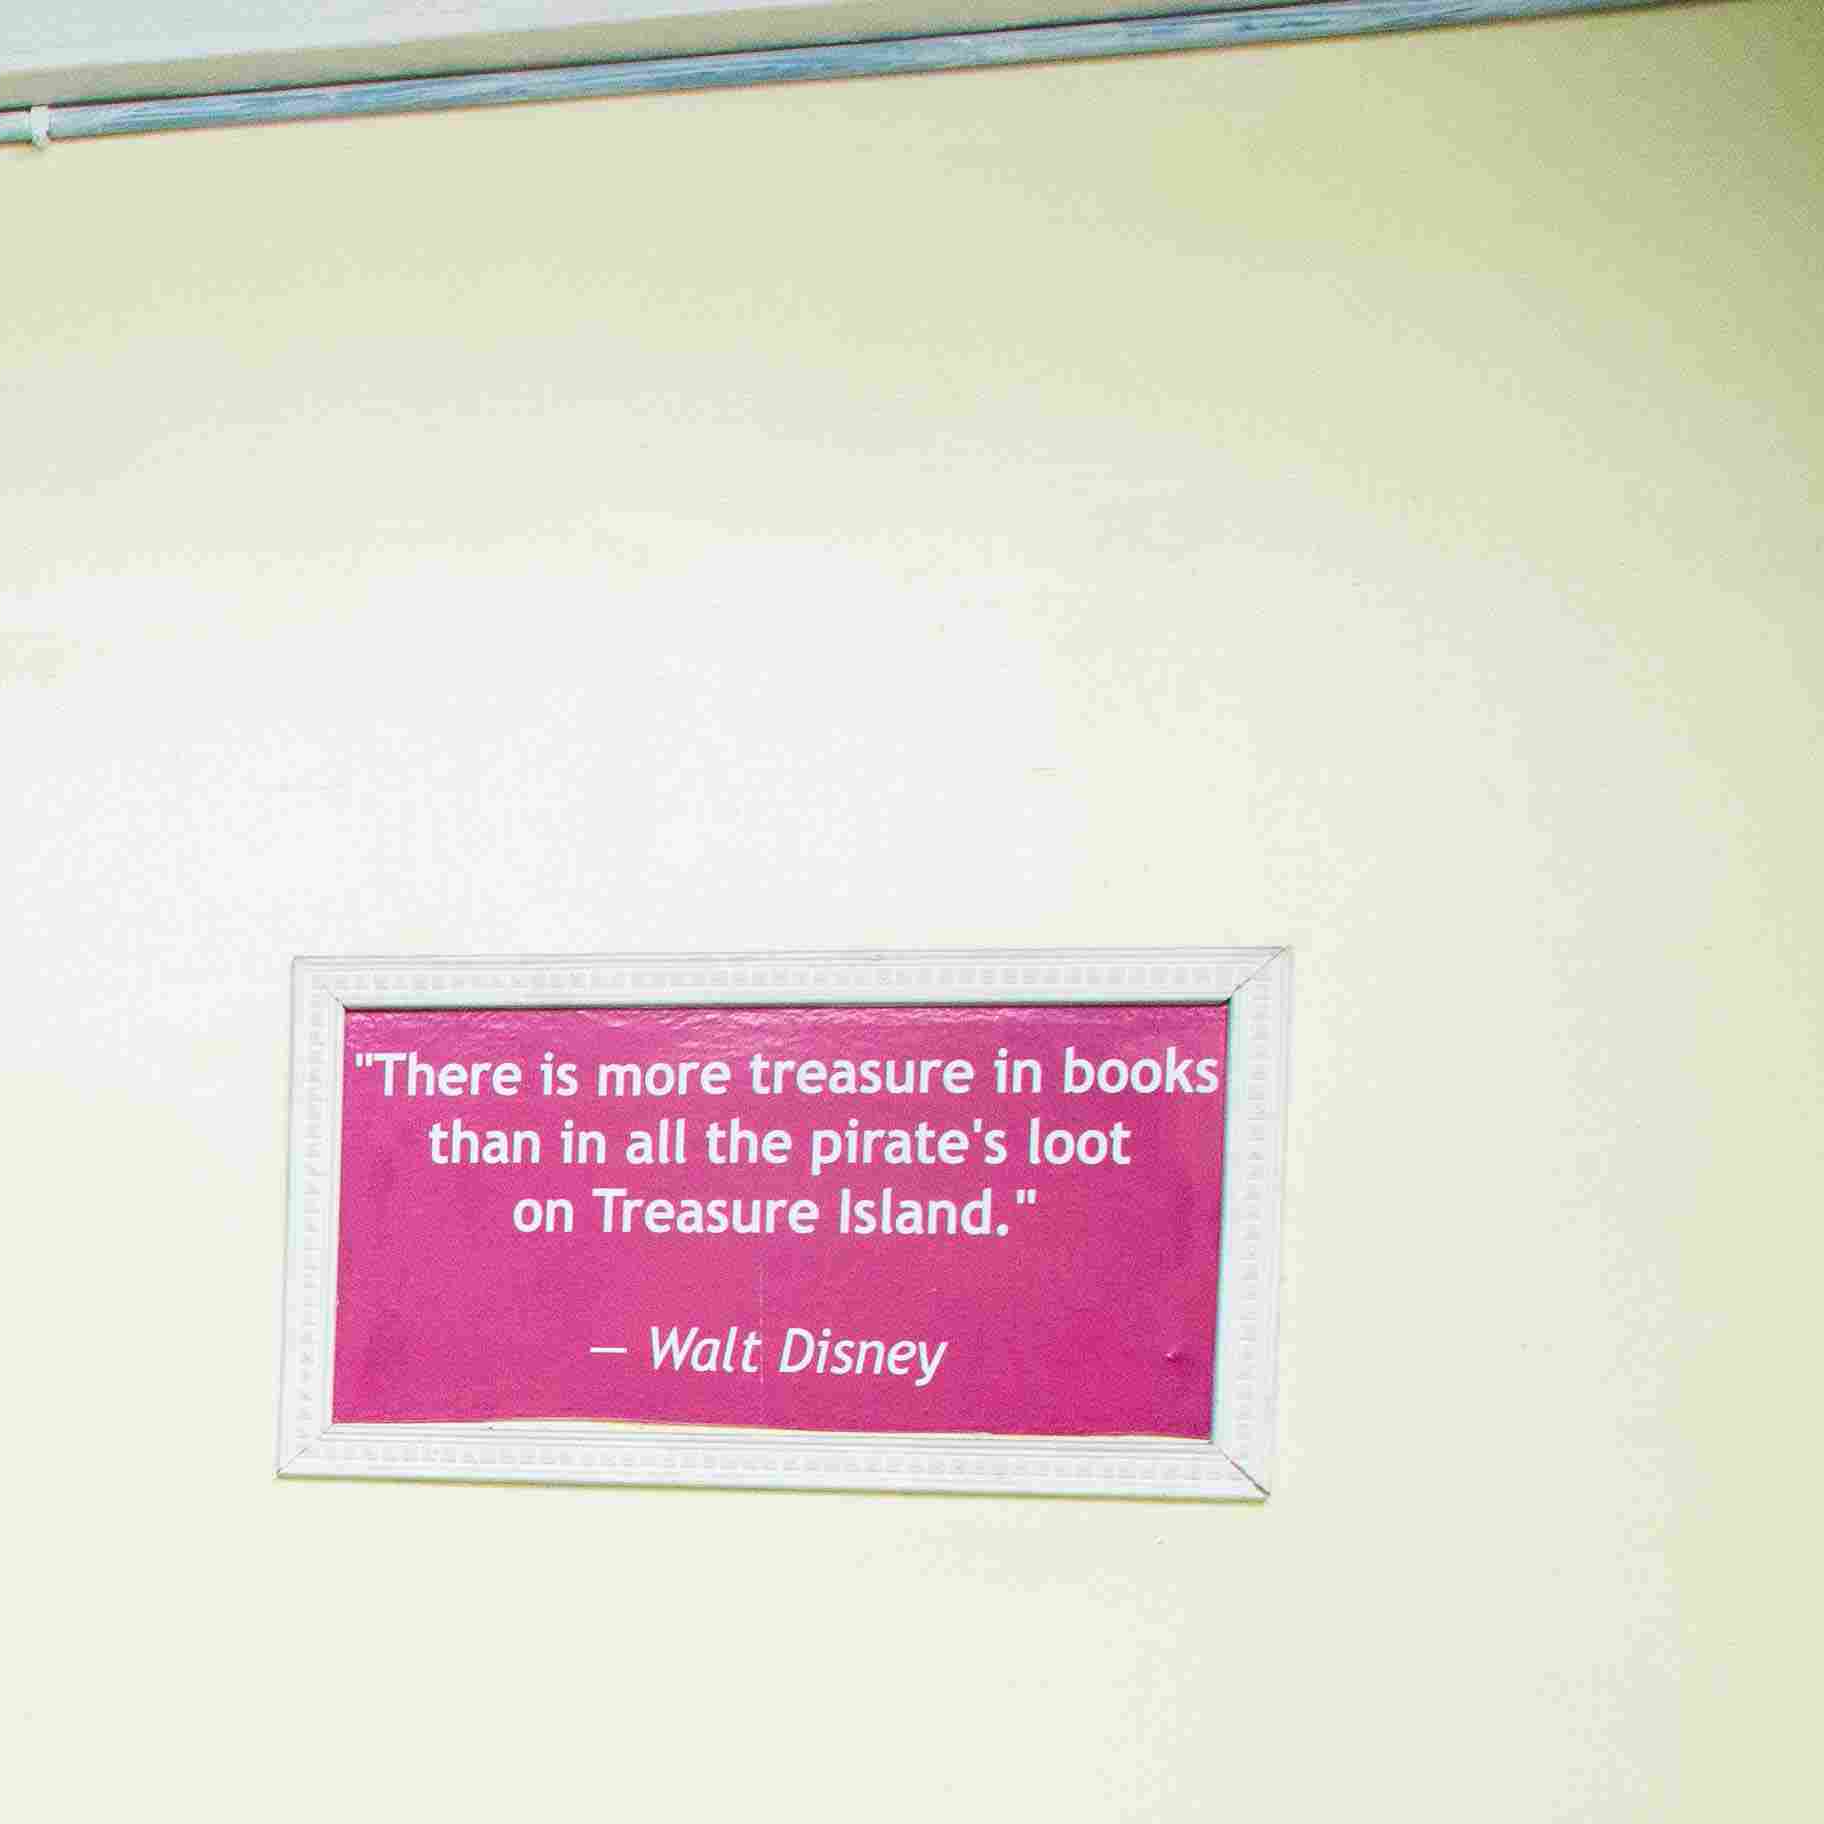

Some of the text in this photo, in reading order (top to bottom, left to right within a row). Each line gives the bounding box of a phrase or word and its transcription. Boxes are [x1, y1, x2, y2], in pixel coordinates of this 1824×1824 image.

[354, 1047, 1219, 1098] "There is more treasure in books
[429, 1118, 1131, 1176] than in all the pirate's loot
[512, 1188, 1036, 1237] on Treasure Island."
[649, 1326, 948, 1388] Walt Disney
